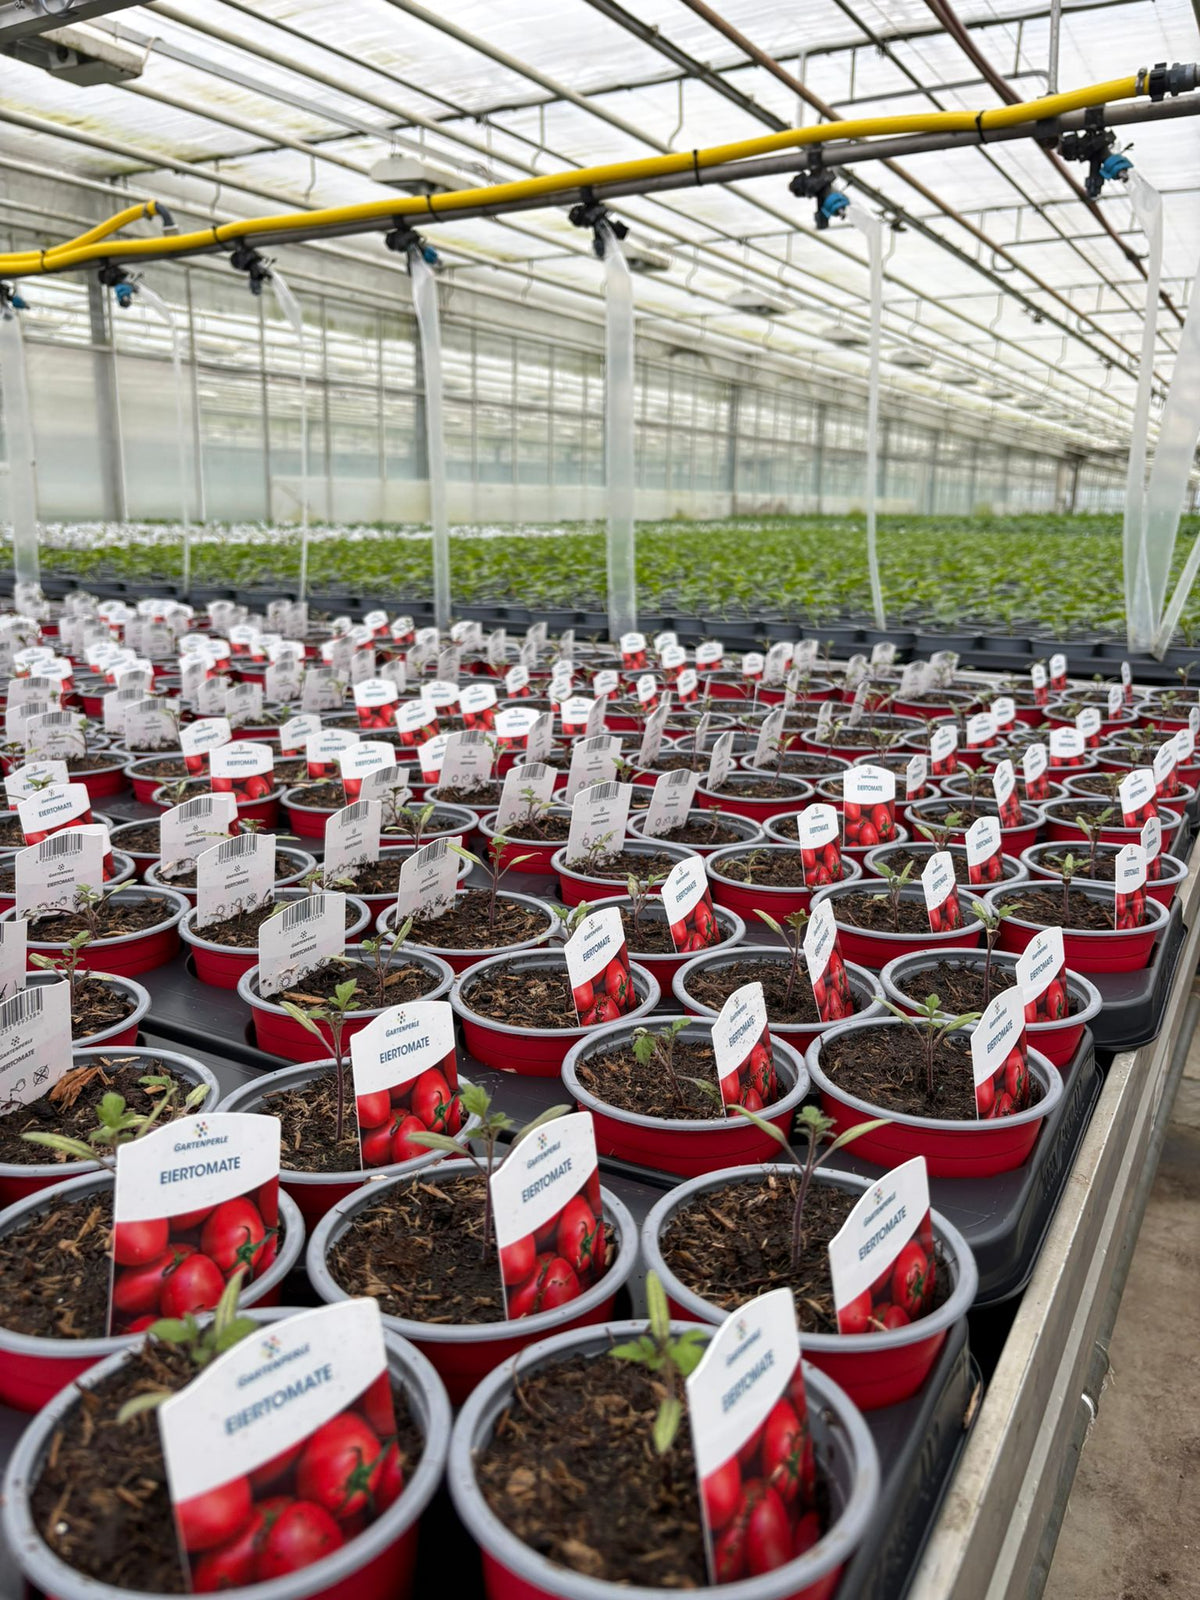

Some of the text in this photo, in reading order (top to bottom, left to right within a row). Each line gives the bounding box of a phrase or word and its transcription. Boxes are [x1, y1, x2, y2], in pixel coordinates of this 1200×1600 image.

[38, 801, 73, 818] EIERTOMATE
[47, 876, 75, 888] EIERTOMATE
[675, 879, 698, 903] EIERTOMATE
[289, 943, 317, 960] EIERTOMATE
[582, 934, 611, 962] EIERTOMATE
[1029, 954, 1054, 981] EIERTOMATE
[385, 1020, 420, 1038] GARTENPERLE
[728, 1014, 757, 1048] EIERTOMATE
[986, 1019, 1013, 1054] EIERTOMATE
[379, 1036, 430, 1064] EIERTOMATE
[173, 1135, 229, 1152] GARTENPERLE
[160, 1156, 241, 1185] EIERTOMATE
[521, 1157, 573, 1203] EIERTOMATE
[858, 1205, 907, 1261] EIERTOMATE
[224, 1362, 333, 1436] EIERTOMATE
